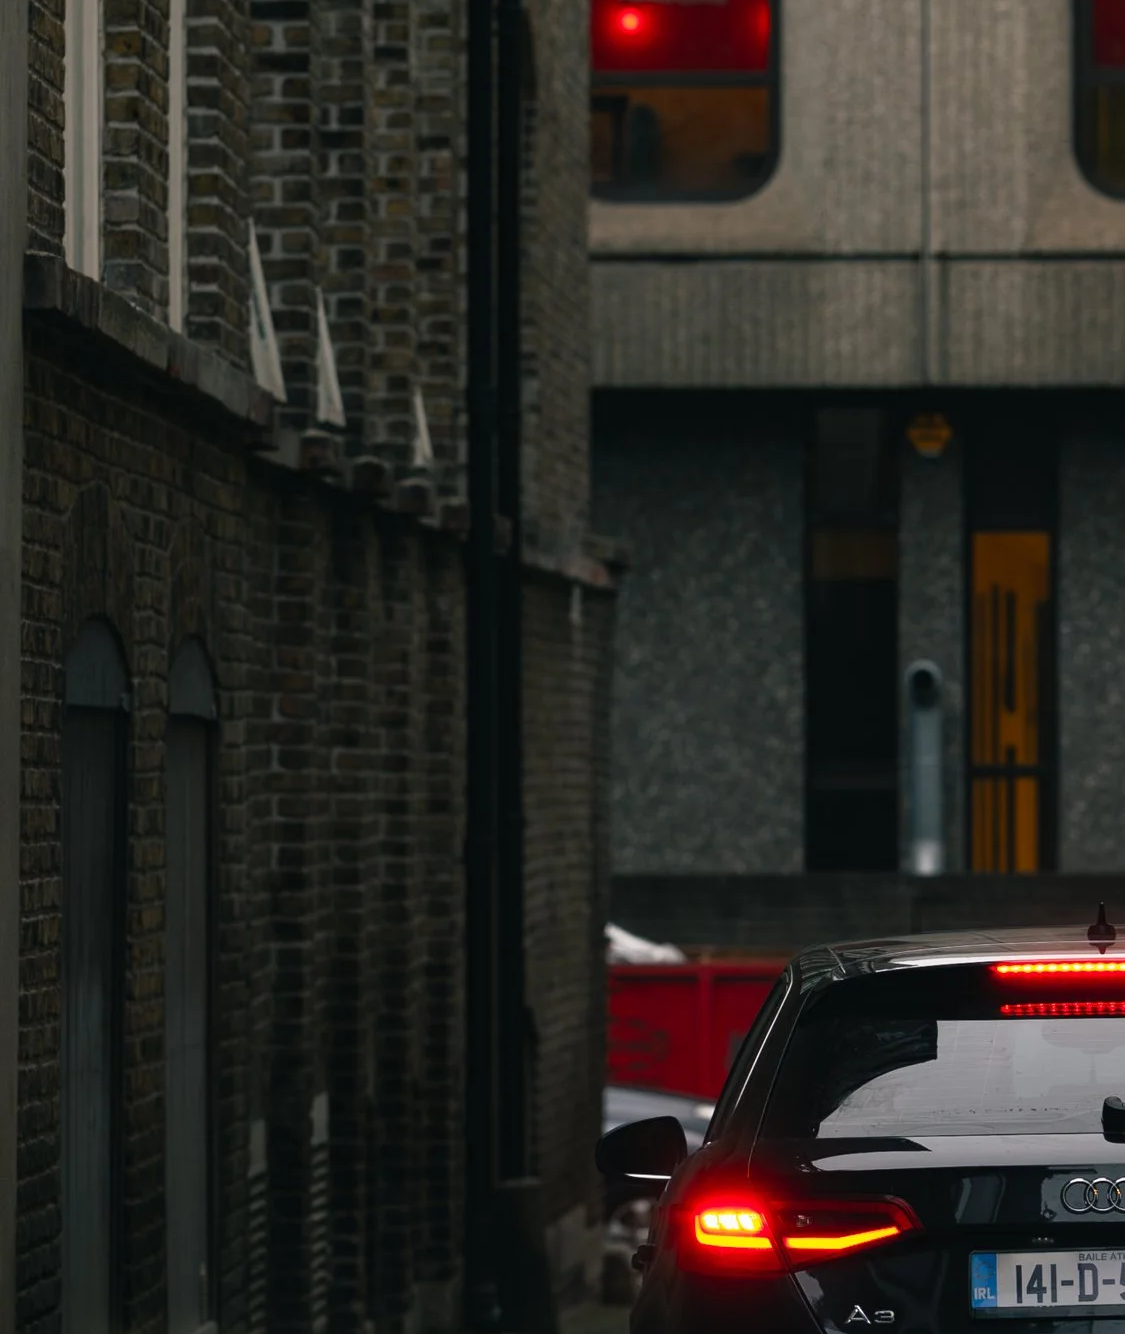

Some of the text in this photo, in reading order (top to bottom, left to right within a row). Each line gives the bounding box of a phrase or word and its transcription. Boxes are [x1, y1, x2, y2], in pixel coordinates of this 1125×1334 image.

[1078, 1253, 1107, 1261] BAILE
[974, 1287, 995, 1300] IRL
[844, 1304, 896, 1325] A3
